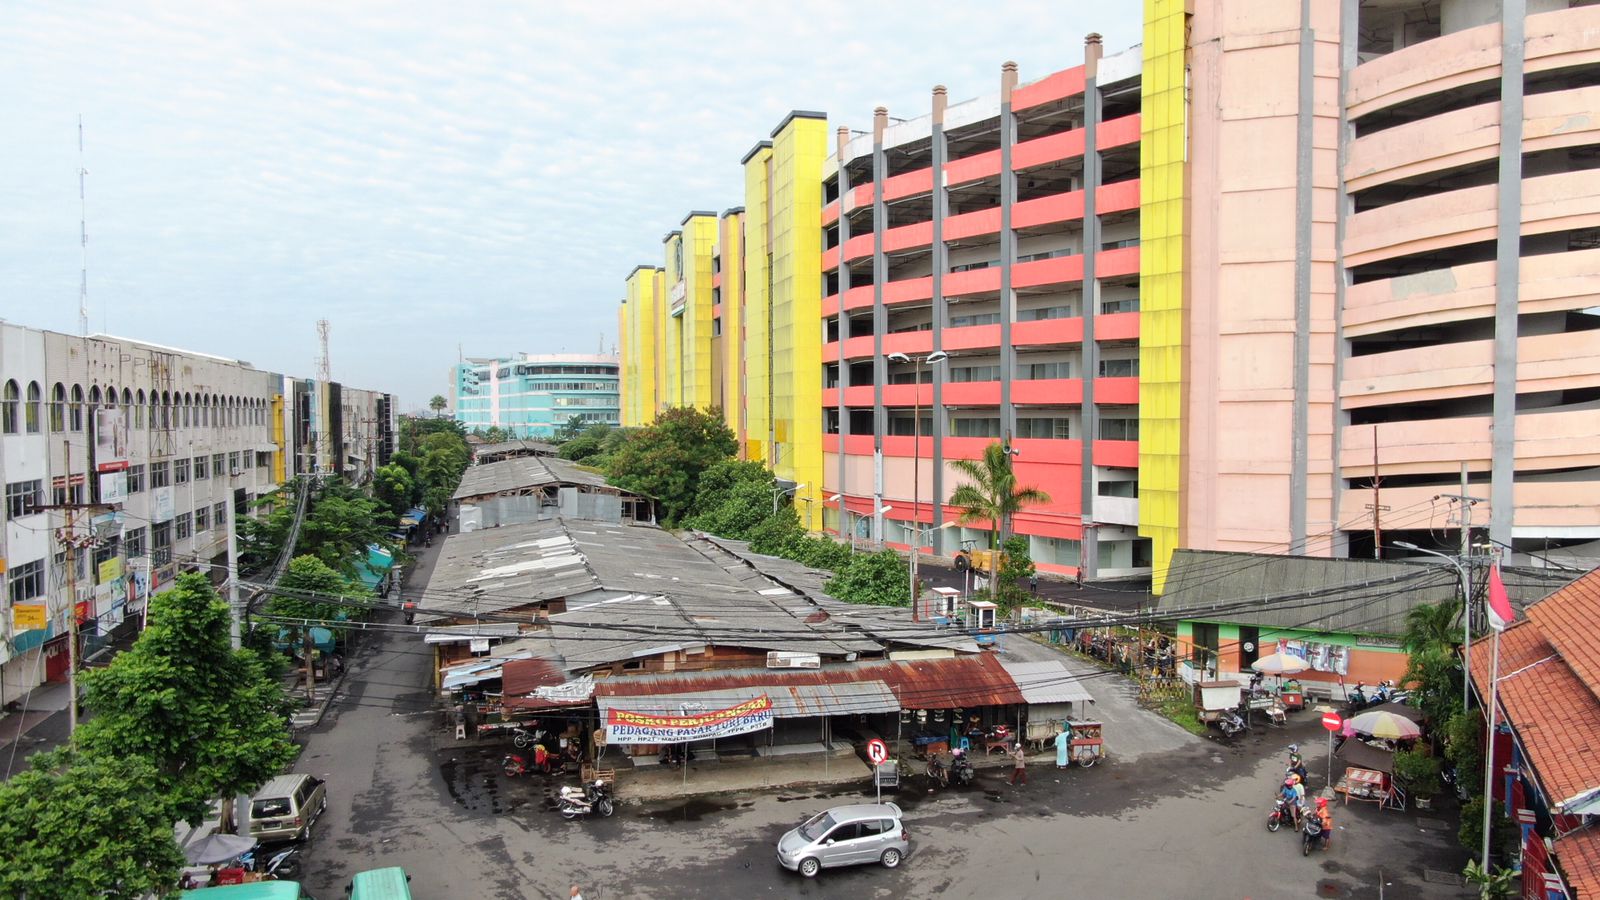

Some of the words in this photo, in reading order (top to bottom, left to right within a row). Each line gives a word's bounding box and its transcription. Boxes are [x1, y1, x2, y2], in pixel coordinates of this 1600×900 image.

[612, 725, 674, 737] PEDAGANG
[676, 724, 713, 737] PASAR
[714, 715, 740, 731] TURI
[743, 709, 771, 725] BARU
[615, 711, 668, 726] POSKO
